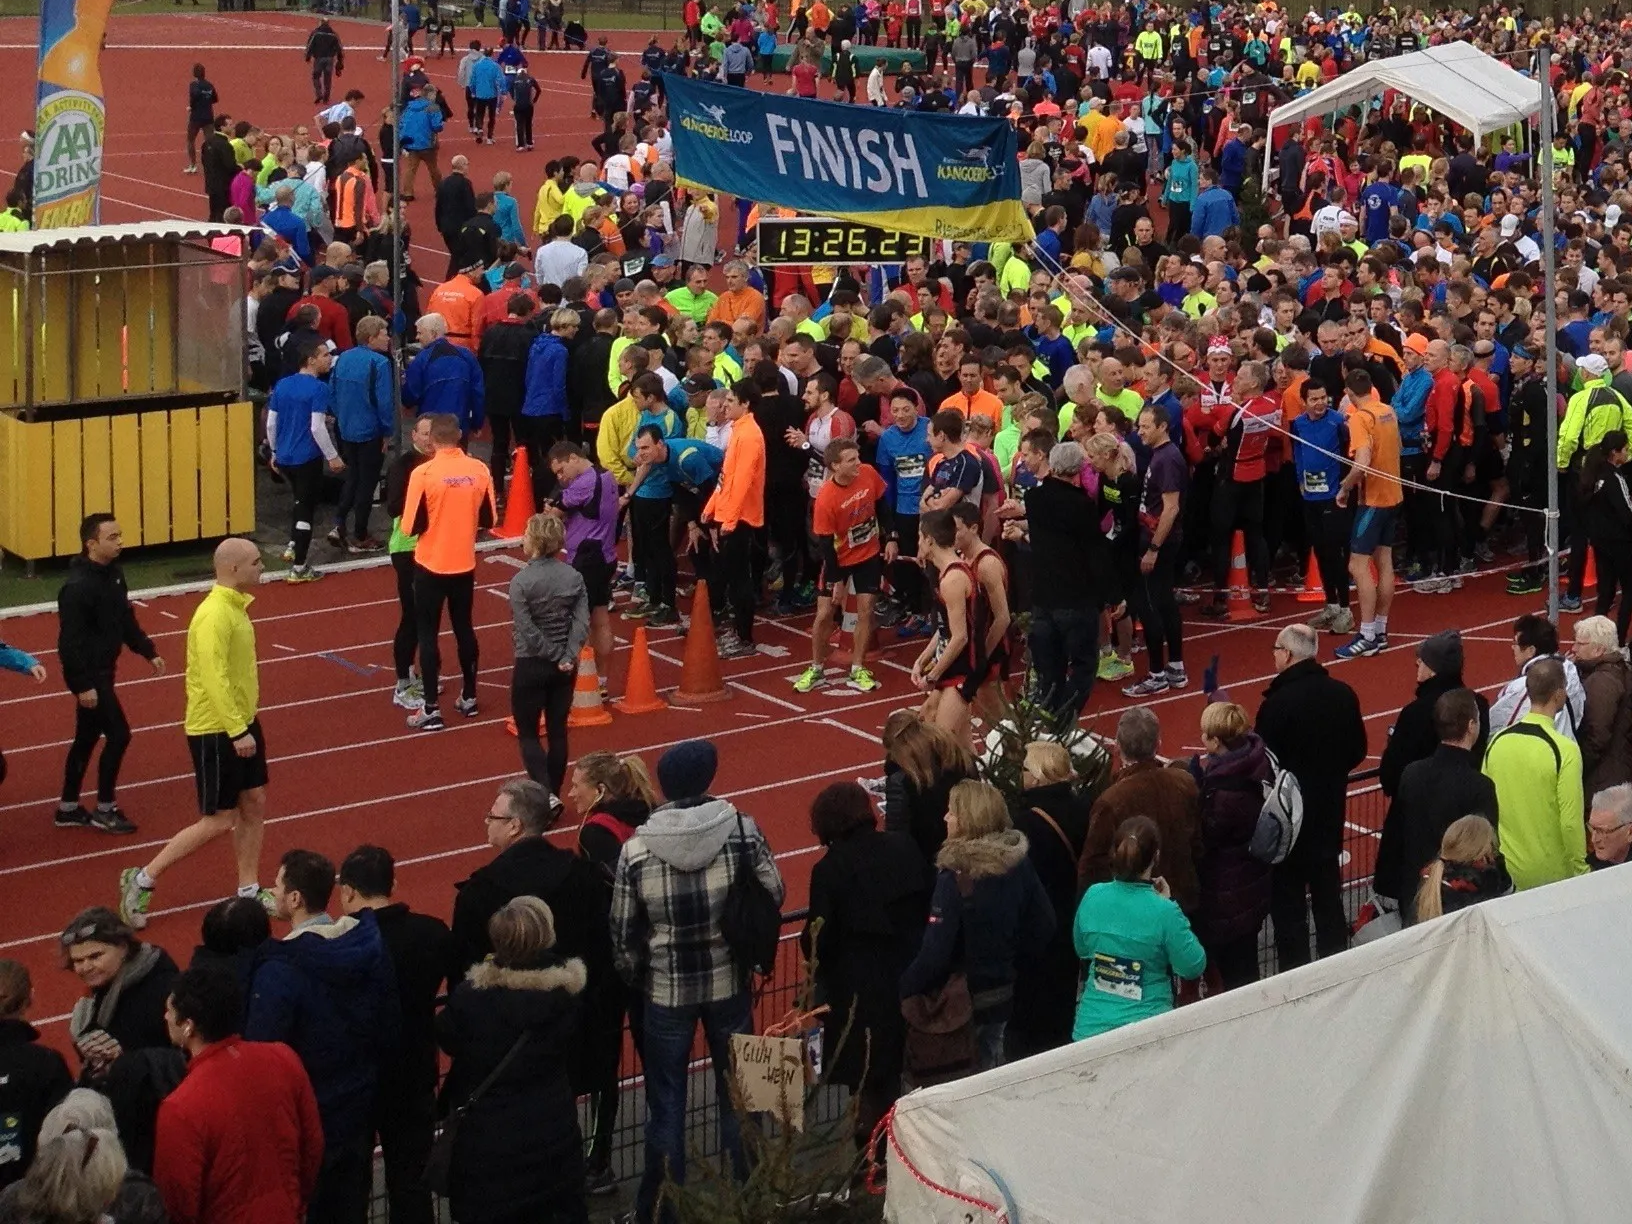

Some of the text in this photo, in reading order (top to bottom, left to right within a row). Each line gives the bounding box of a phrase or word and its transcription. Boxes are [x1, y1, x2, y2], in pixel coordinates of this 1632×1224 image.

[47, 122, 92, 167] AA
[765, 111, 929, 199] FINISH
[35, 156, 101, 194] DRINK
